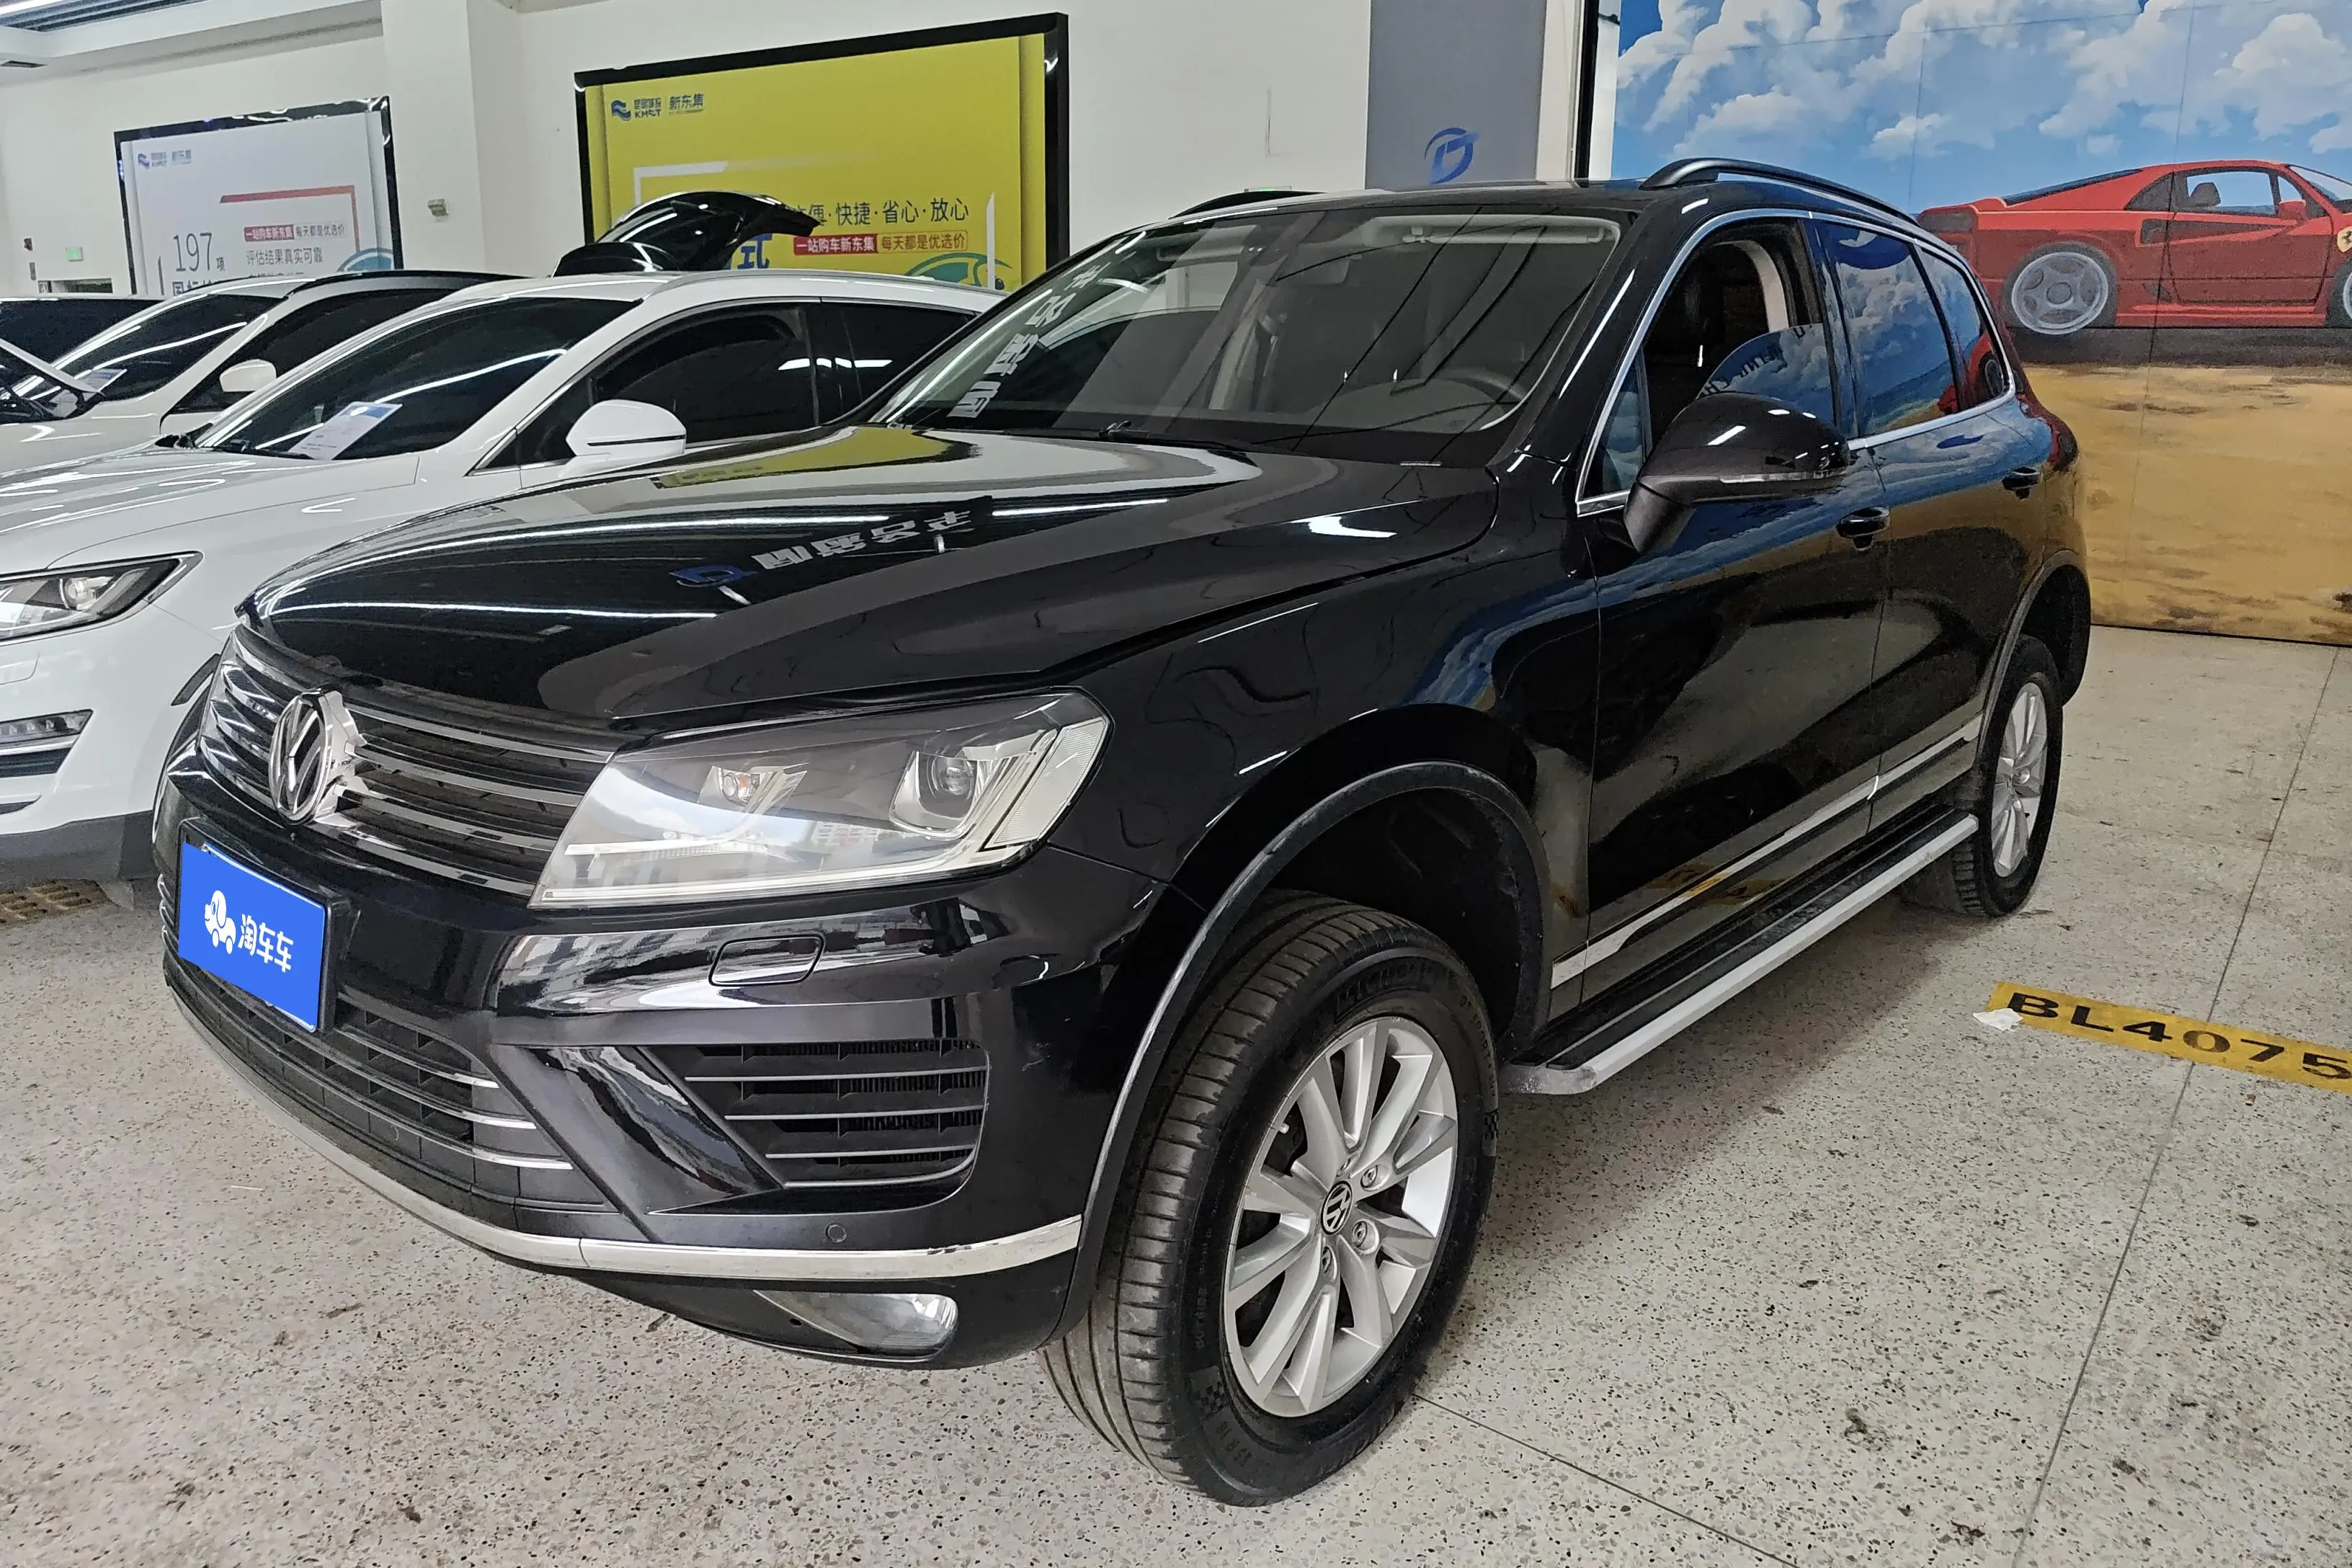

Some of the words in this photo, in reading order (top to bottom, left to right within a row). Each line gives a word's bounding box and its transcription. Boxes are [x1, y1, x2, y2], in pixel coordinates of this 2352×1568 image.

[796, 236, 875, 254] 一站购车新东集
[881, 233, 965, 250] 每天都是优选价
[246, 246, 323, 265] 评估结果真实可靠
[2007, 992, 2352, 1079] BL4075
